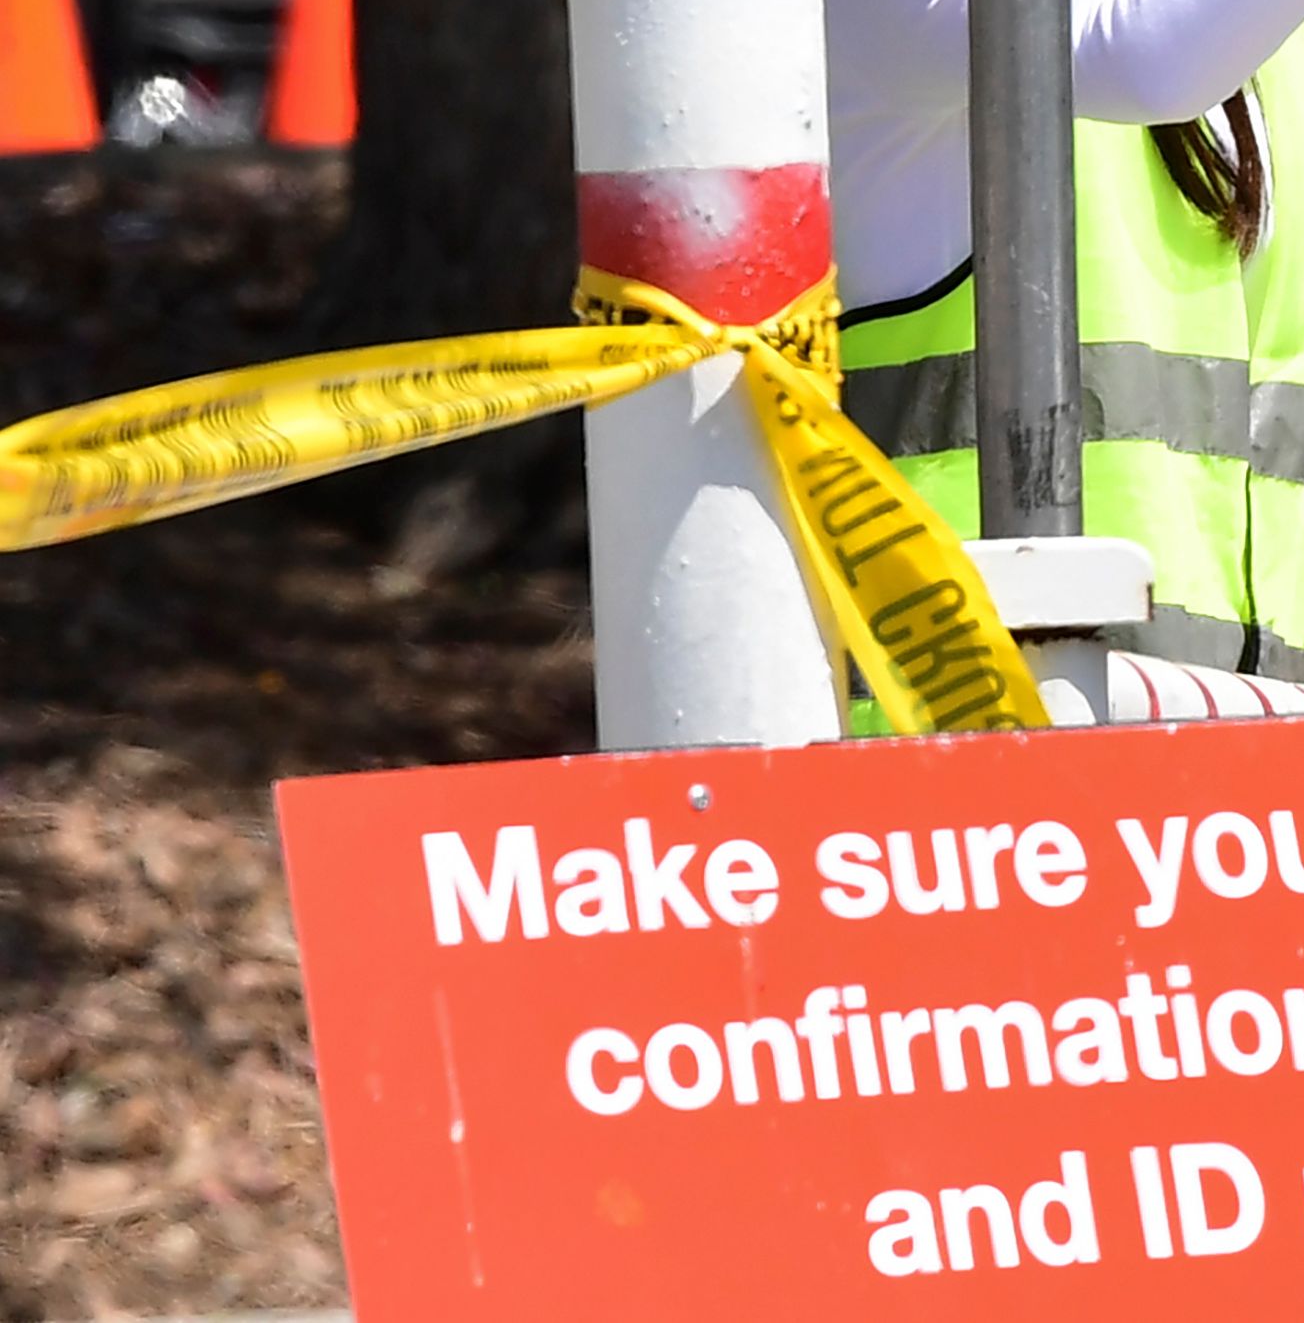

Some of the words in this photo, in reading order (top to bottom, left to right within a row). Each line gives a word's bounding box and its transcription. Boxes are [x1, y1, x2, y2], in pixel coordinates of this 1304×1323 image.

[421, 817, 780, 946] Make
[815, 820, 1088, 920] sure
[864, 1149, 1101, 1278] and
[1129, 1142, 1266, 1259] ID
